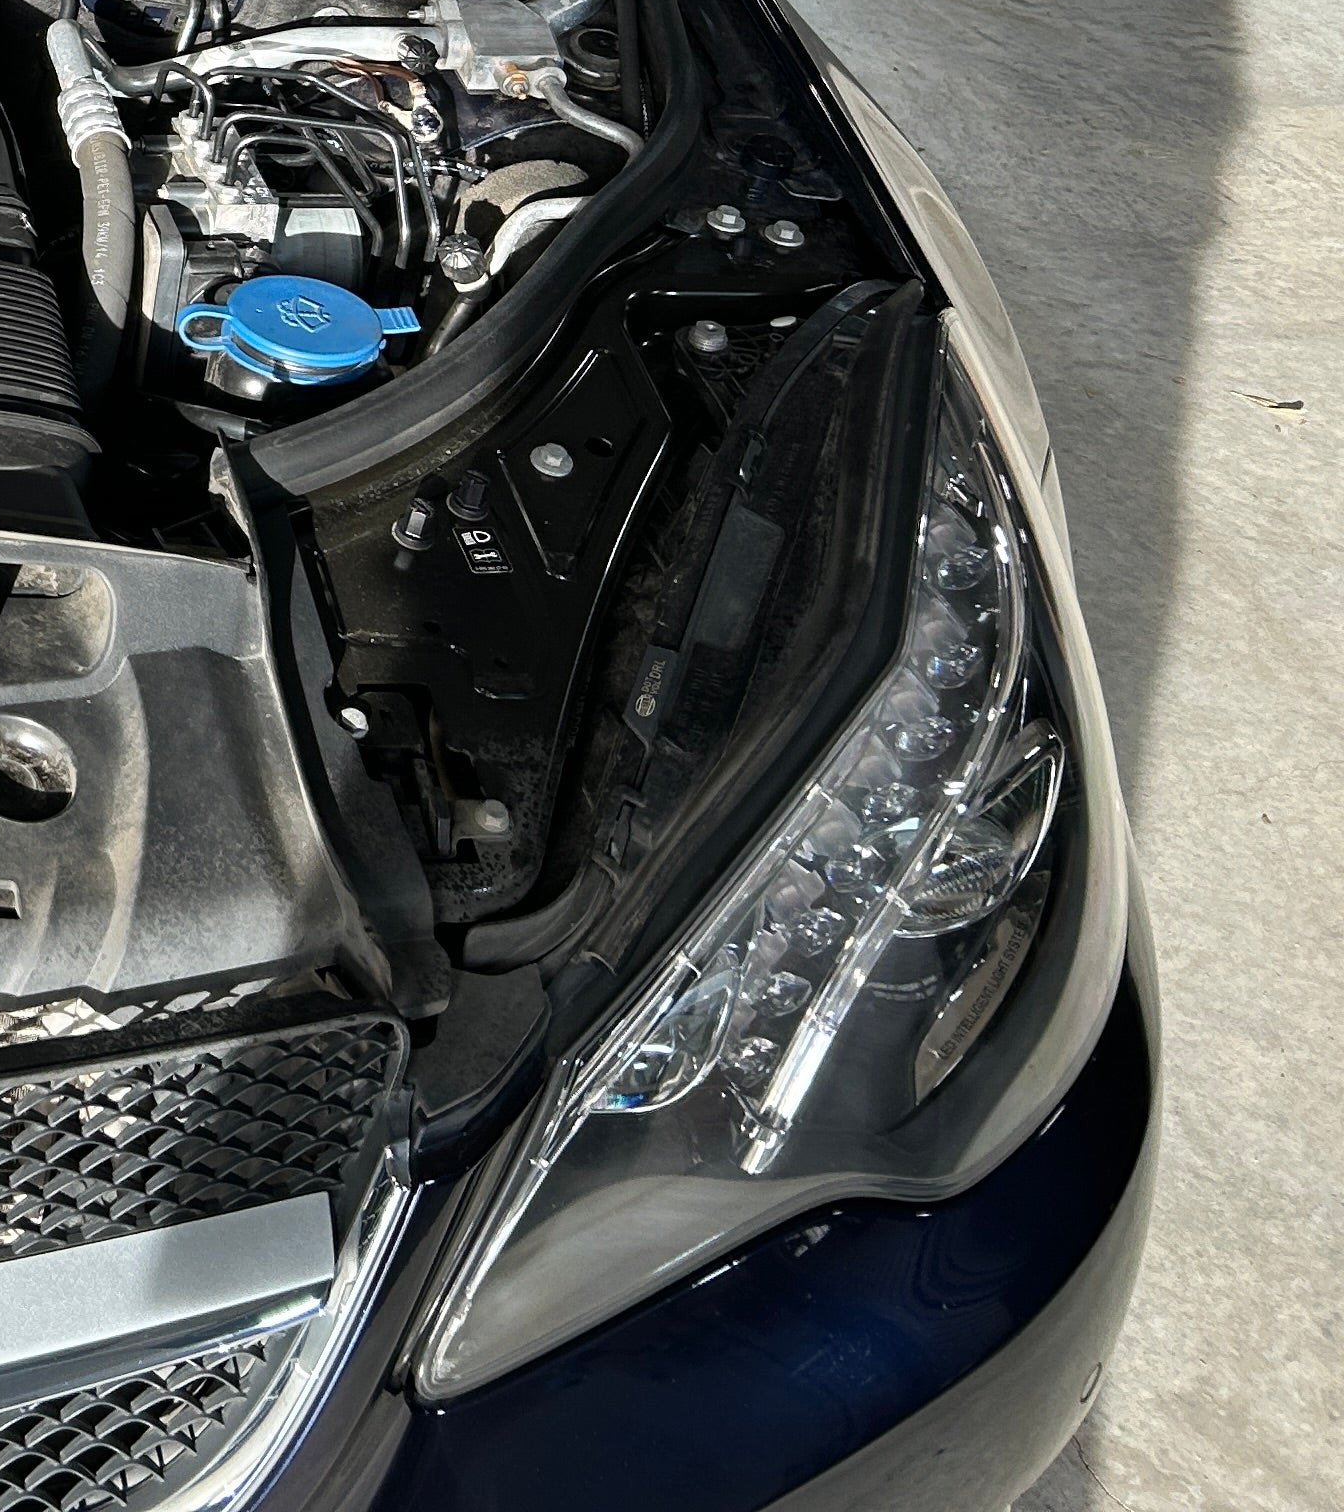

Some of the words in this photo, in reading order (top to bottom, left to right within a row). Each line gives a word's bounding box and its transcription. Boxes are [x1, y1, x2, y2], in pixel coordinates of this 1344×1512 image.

[649, 660, 666, 679] DRL
[952, 986, 993, 1044] INTELLIGENT
[991, 960, 1009, 990] LIGHT
